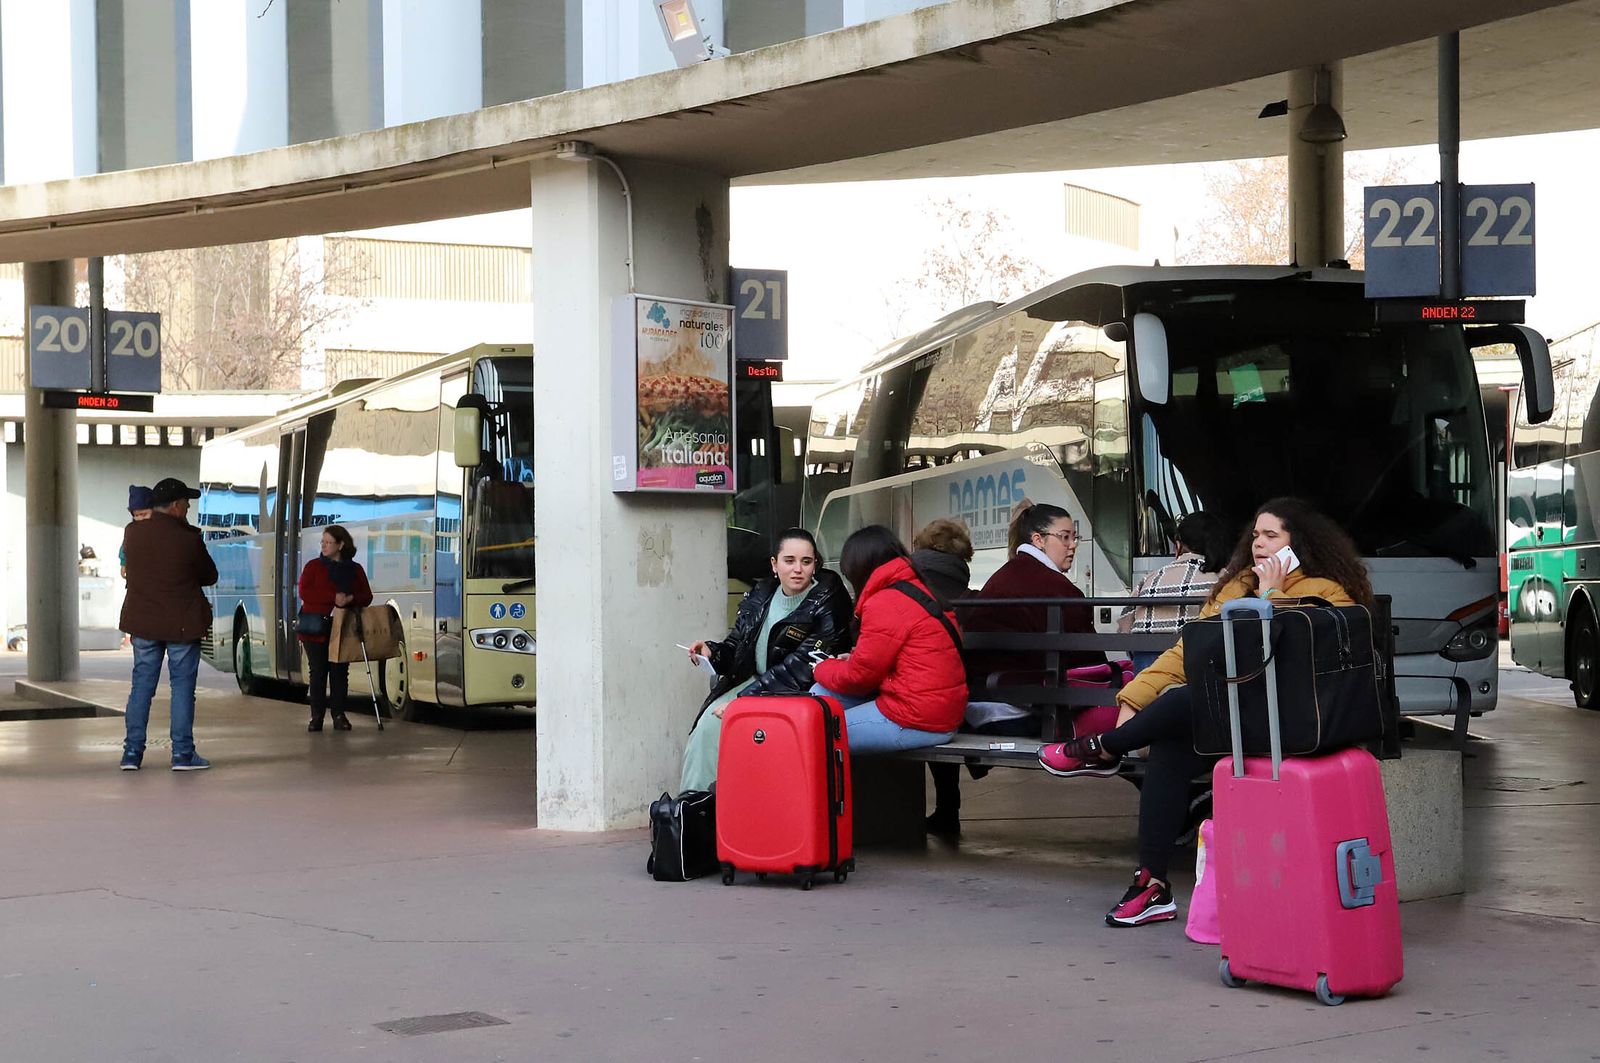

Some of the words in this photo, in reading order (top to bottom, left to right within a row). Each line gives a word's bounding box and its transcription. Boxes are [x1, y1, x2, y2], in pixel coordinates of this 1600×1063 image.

[1369, 197, 1436, 248] 22
[1465, 196, 1533, 246] 22
[739, 279, 781, 320] 21
[1421, 306, 1458, 319] ANDEN
[1460, 306, 1476, 318] 22
[34, 315, 88, 353] 20
[109, 319, 159, 358] 20
[680, 319, 725, 332] naturales
[748, 365, 778, 377] Destin
[78, 396, 106, 407] ANDEN
[107, 398, 118, 407] 20
[661, 444, 726, 466] italiana
